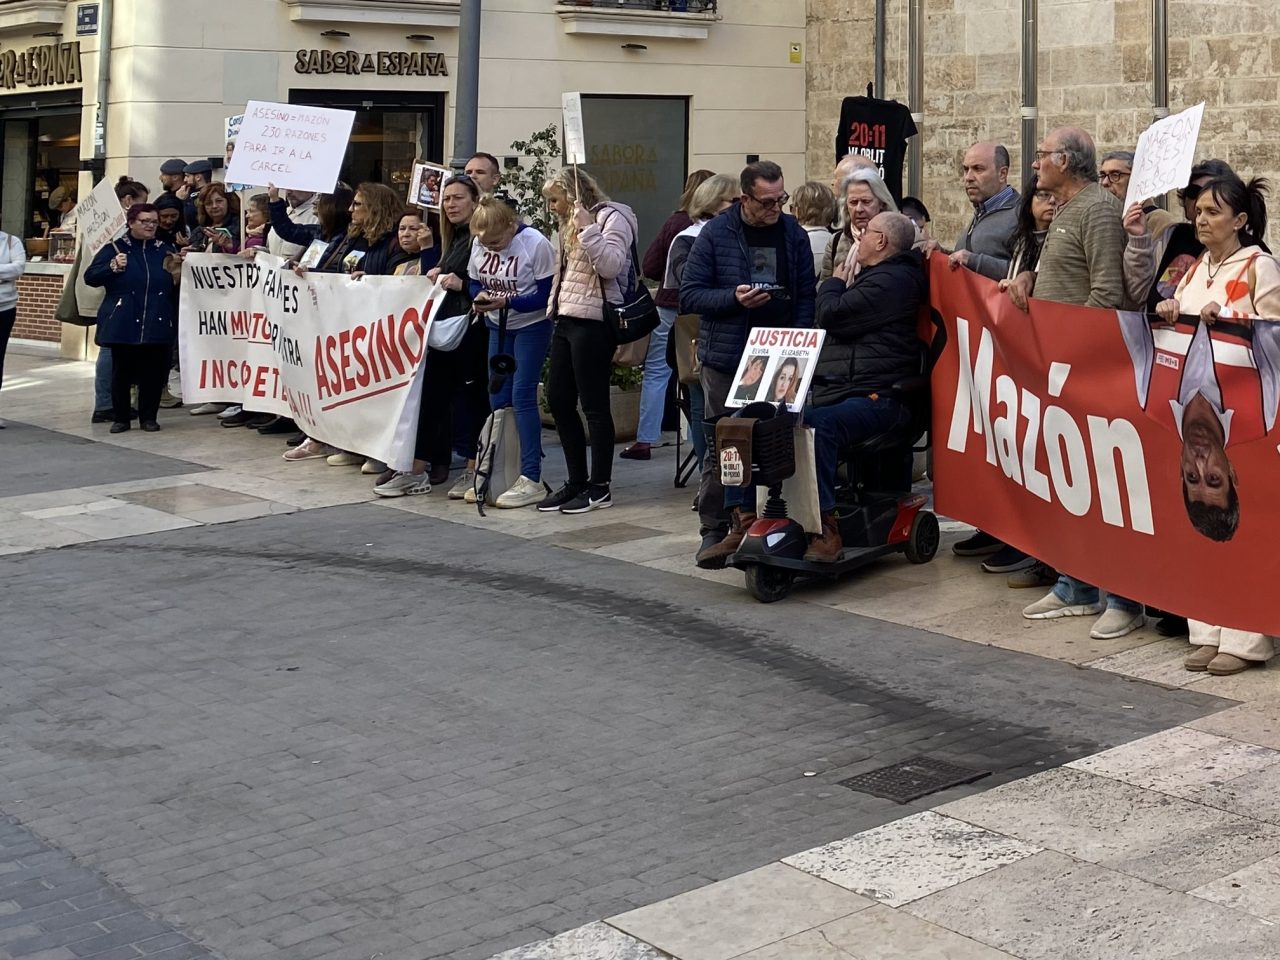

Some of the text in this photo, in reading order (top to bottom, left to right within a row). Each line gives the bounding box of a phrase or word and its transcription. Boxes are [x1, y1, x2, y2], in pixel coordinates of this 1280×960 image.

[25, 41, 82, 87] ESPAÑA
[295, 50, 448, 76] SABOR A ESPAÑA
[261, 125, 281, 138] 230
[848, 121, 886, 149] 20:11
[243, 141, 267, 153] PARA
[289, 149, 296, 158] A
[479, 251, 519, 277] 20:11
[198, 310, 228, 336] HAN
[750, 329, 819, 348] JUSTICIA
[947, 317, 1155, 536] Mazón
